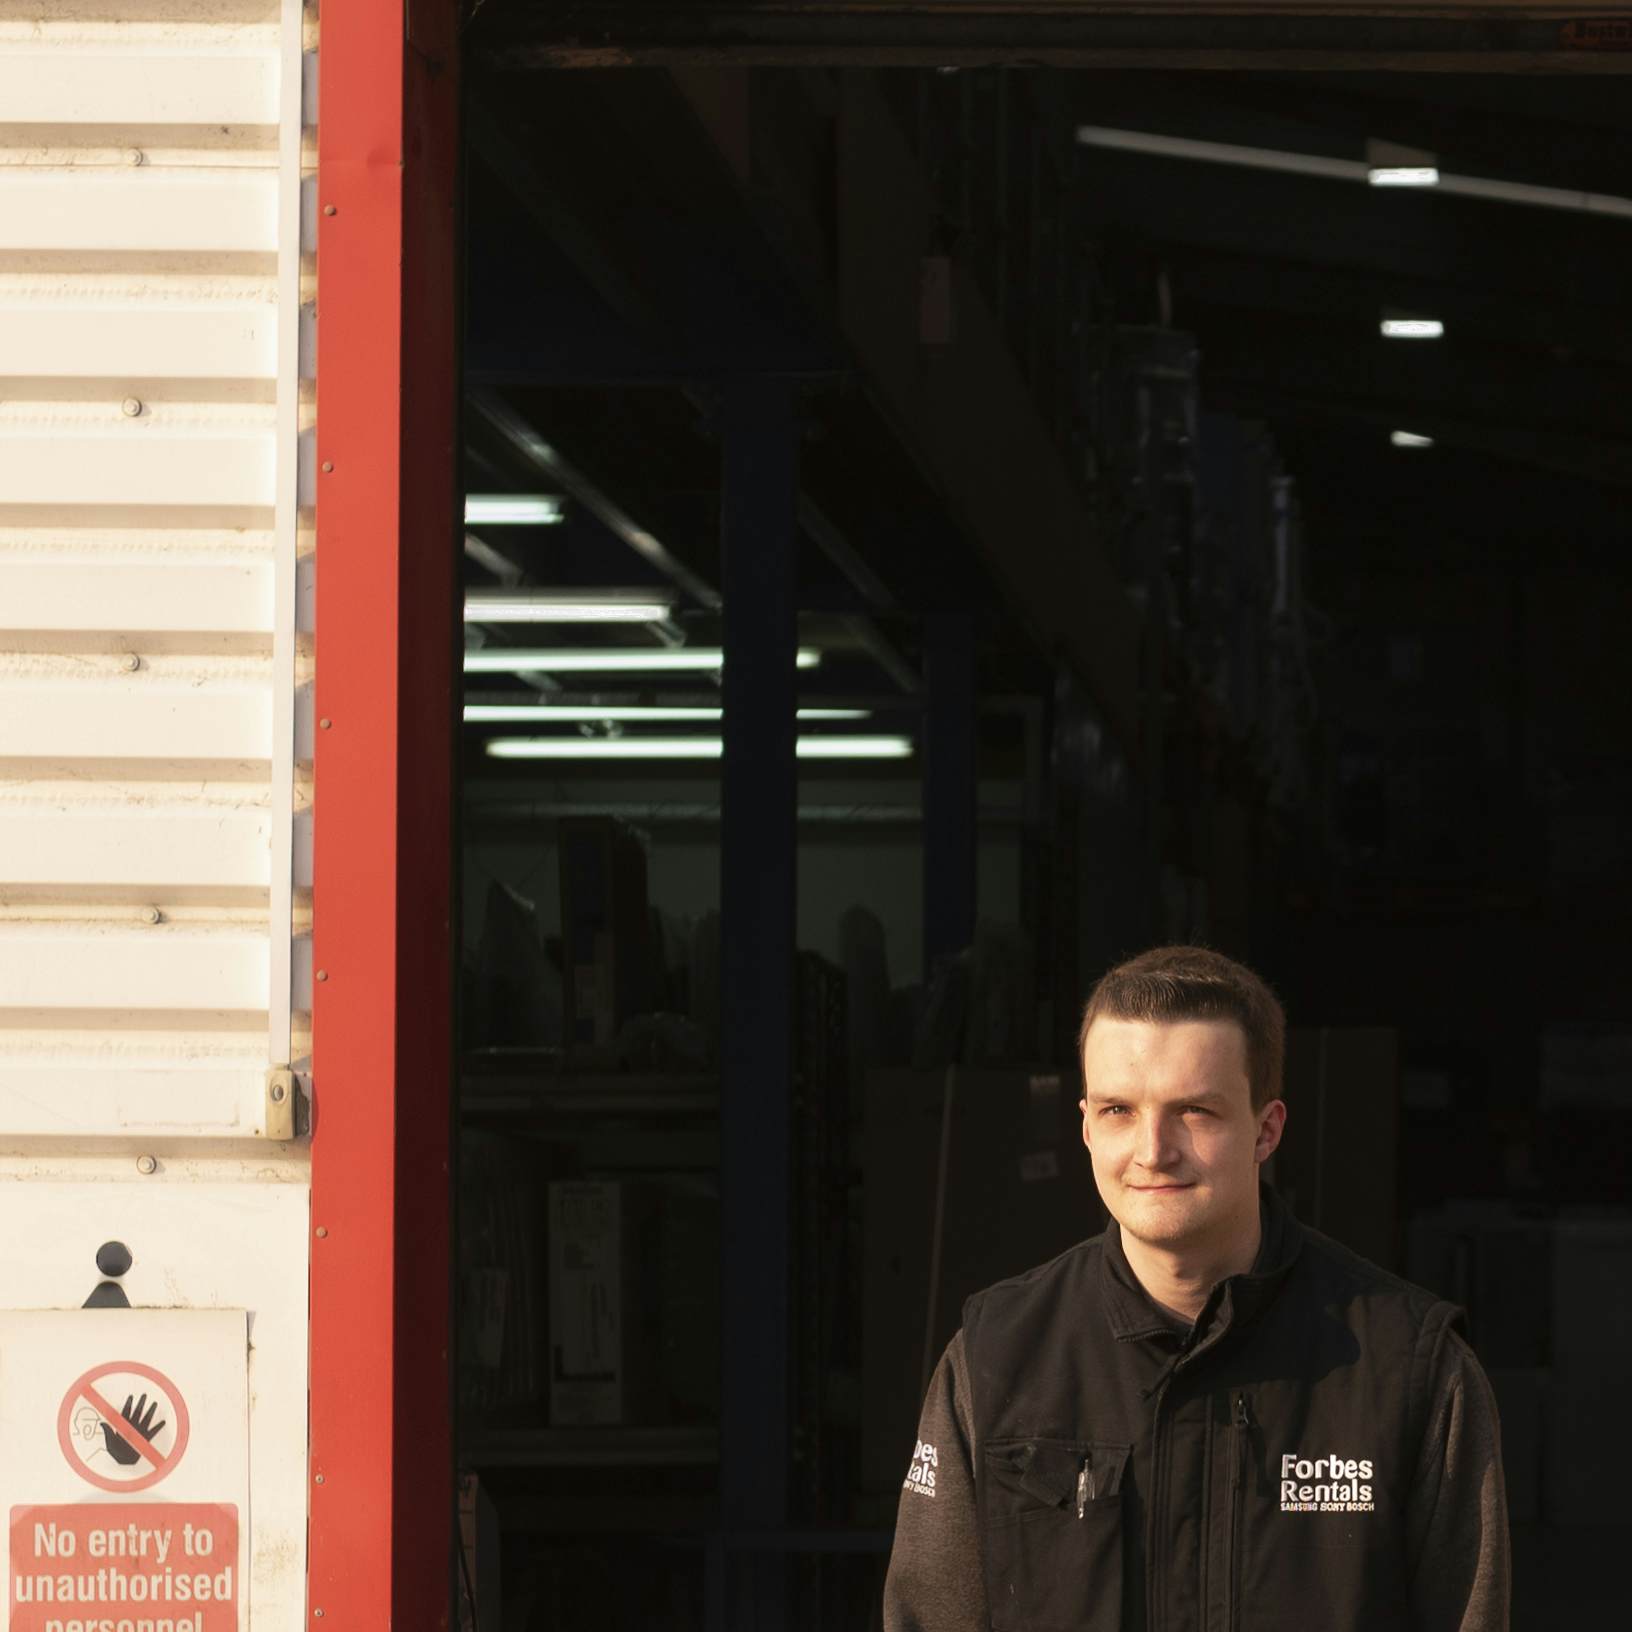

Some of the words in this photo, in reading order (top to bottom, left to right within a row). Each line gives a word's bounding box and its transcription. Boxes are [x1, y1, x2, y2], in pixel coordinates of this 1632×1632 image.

[1281, 1454, 1374, 1480] Forbes
[1281, 1478, 1373, 1502] Rentals
[1280, 1502, 1318, 1511] SAMSUNG
[1320, 1502, 1346, 1512] SONY
[1346, 1502, 1375, 1512] BOSCH
[34, 1523, 76, 1558] No
[88, 1524, 172, 1563] entry
[184, 1523, 213, 1557] to
[16, 1567, 233, 1603] unauthorised
